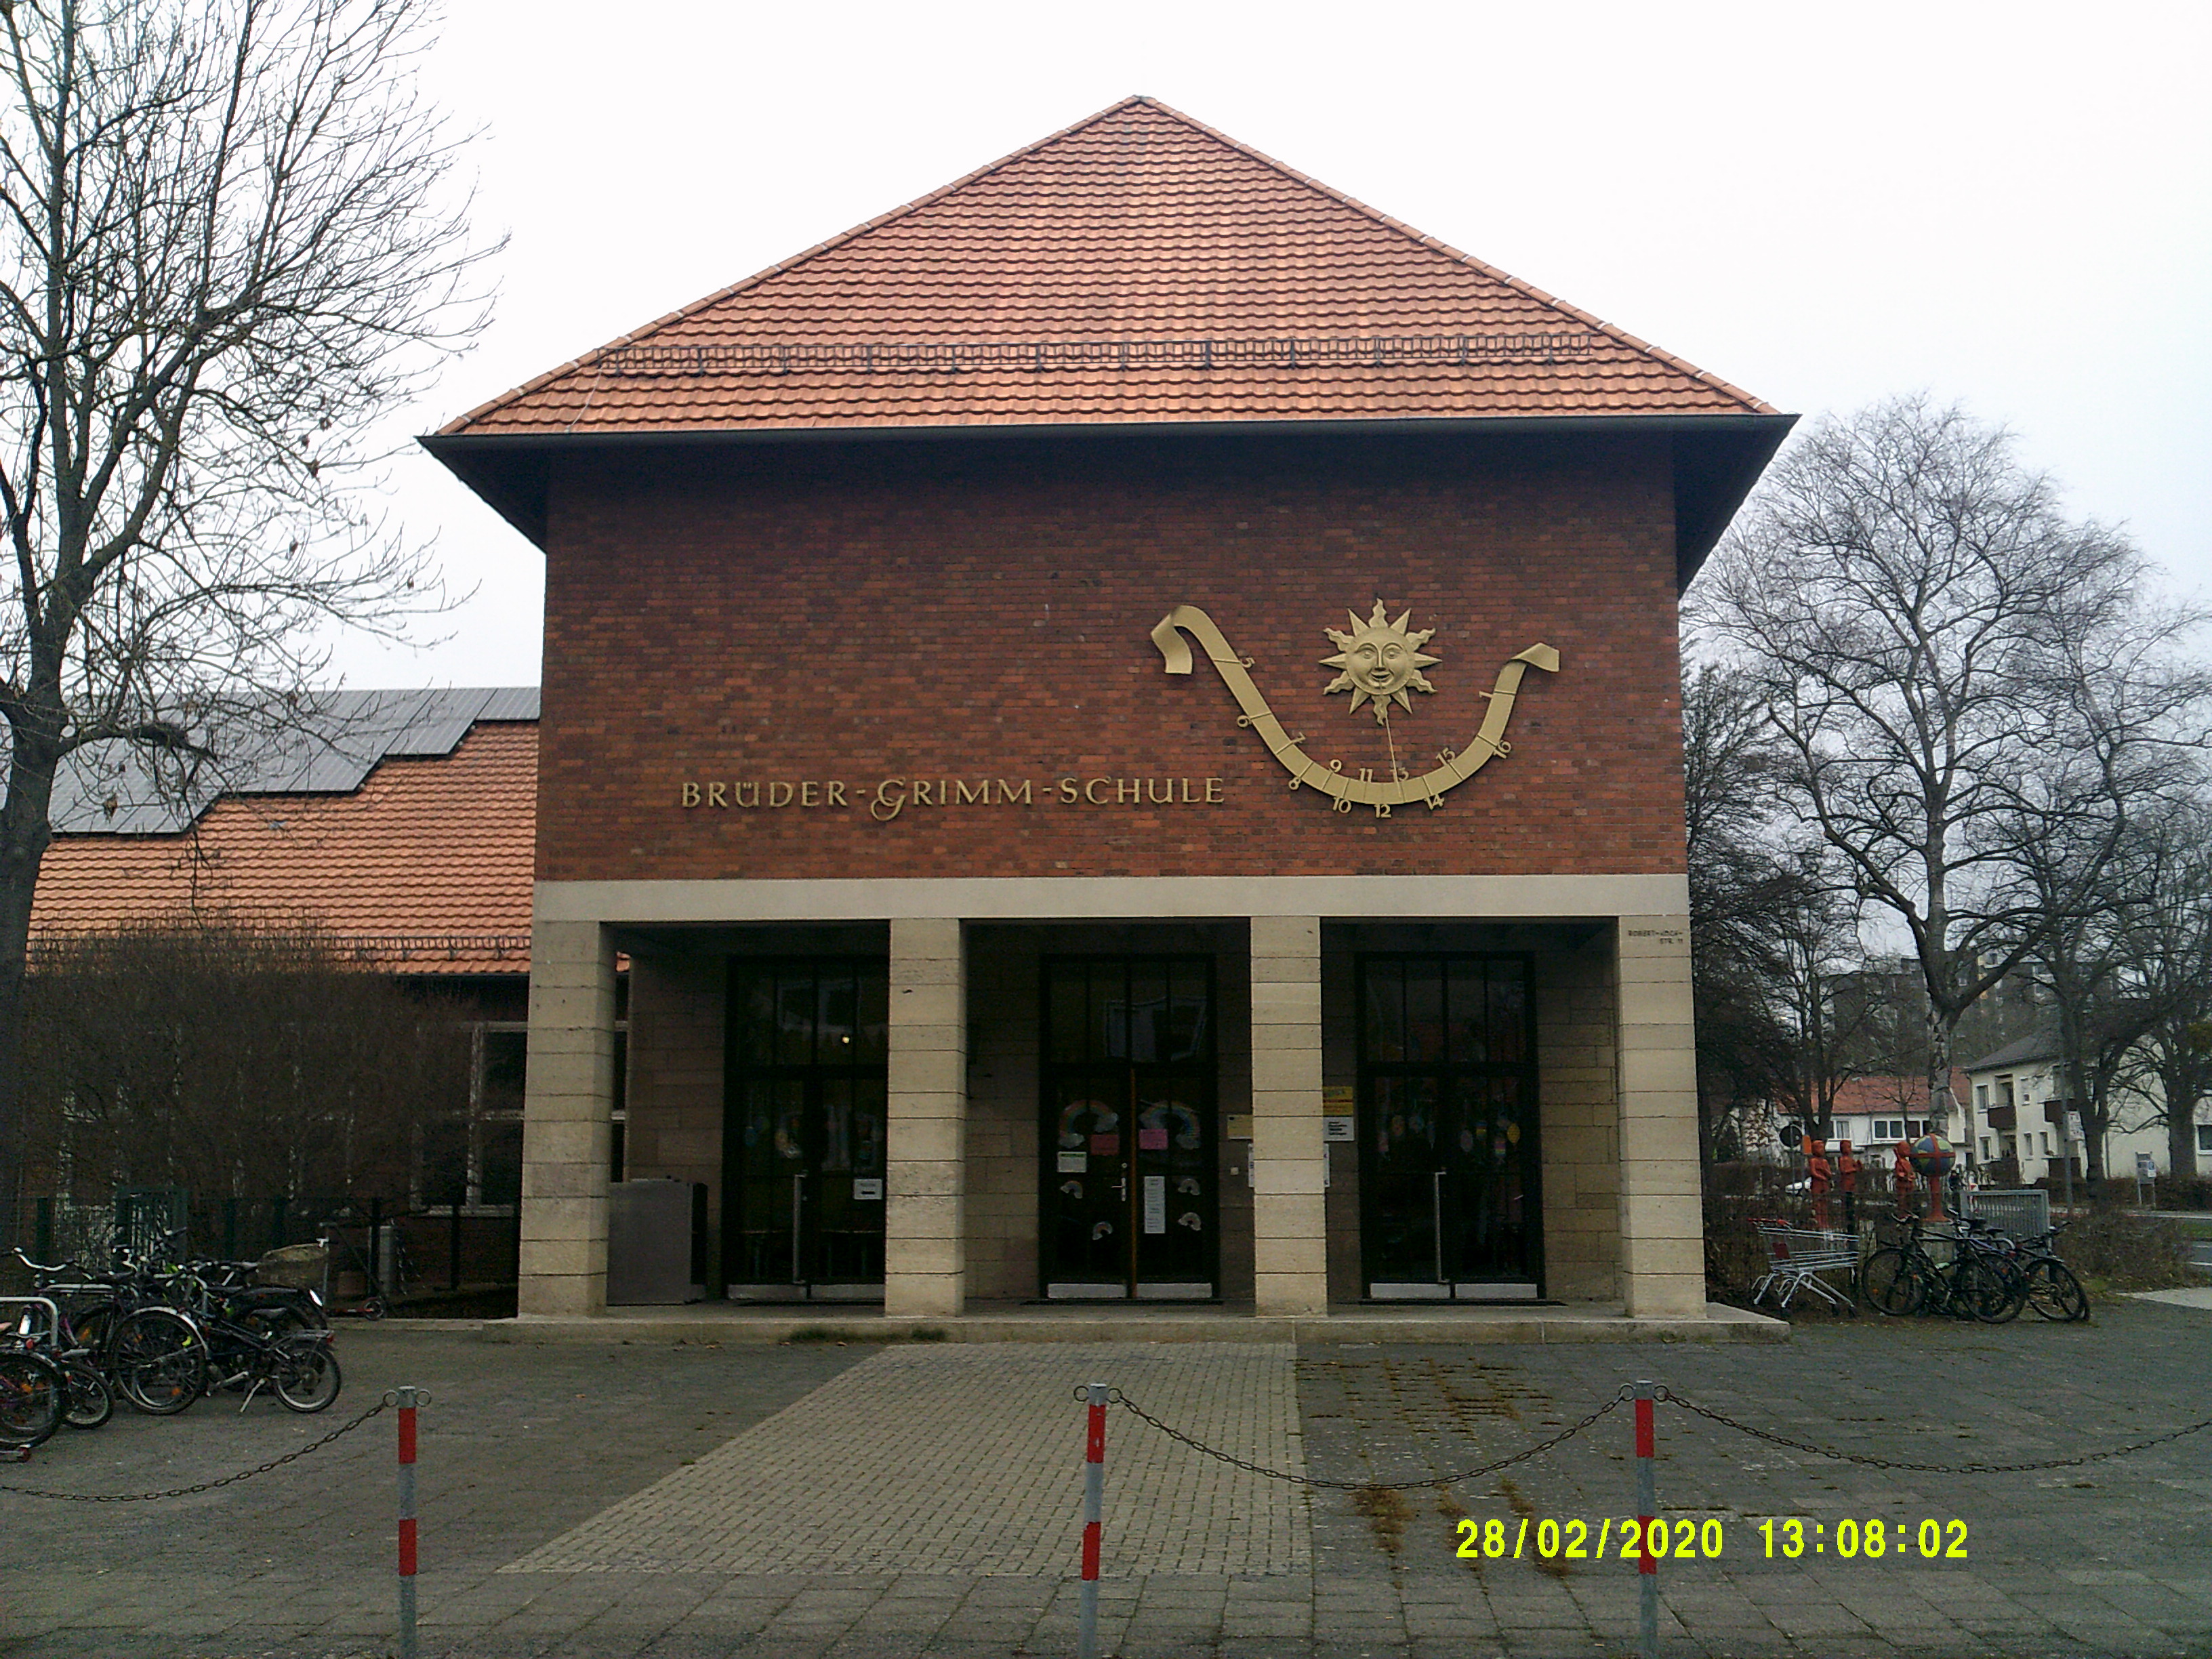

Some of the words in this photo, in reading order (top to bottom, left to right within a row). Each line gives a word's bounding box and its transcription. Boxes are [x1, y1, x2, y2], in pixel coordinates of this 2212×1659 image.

[1241, 657, 1256, 669] 5
[1237, 715, 1252, 729] 6
[1292, 732, 1307, 745] 7
[1436, 747, 1456, 766] 15
[1494, 739, 1512, 759] 16
[1329, 758, 1343, 773] 9
[1359, 768, 1373, 783] 11
[1390, 767, 1410, 782] 13
[1288, 776, 1301, 791] 8
[1332, 796, 1353, 814] 10
[1424, 794, 1445, 811] 14
[1374, 804, 1392, 819] 12
